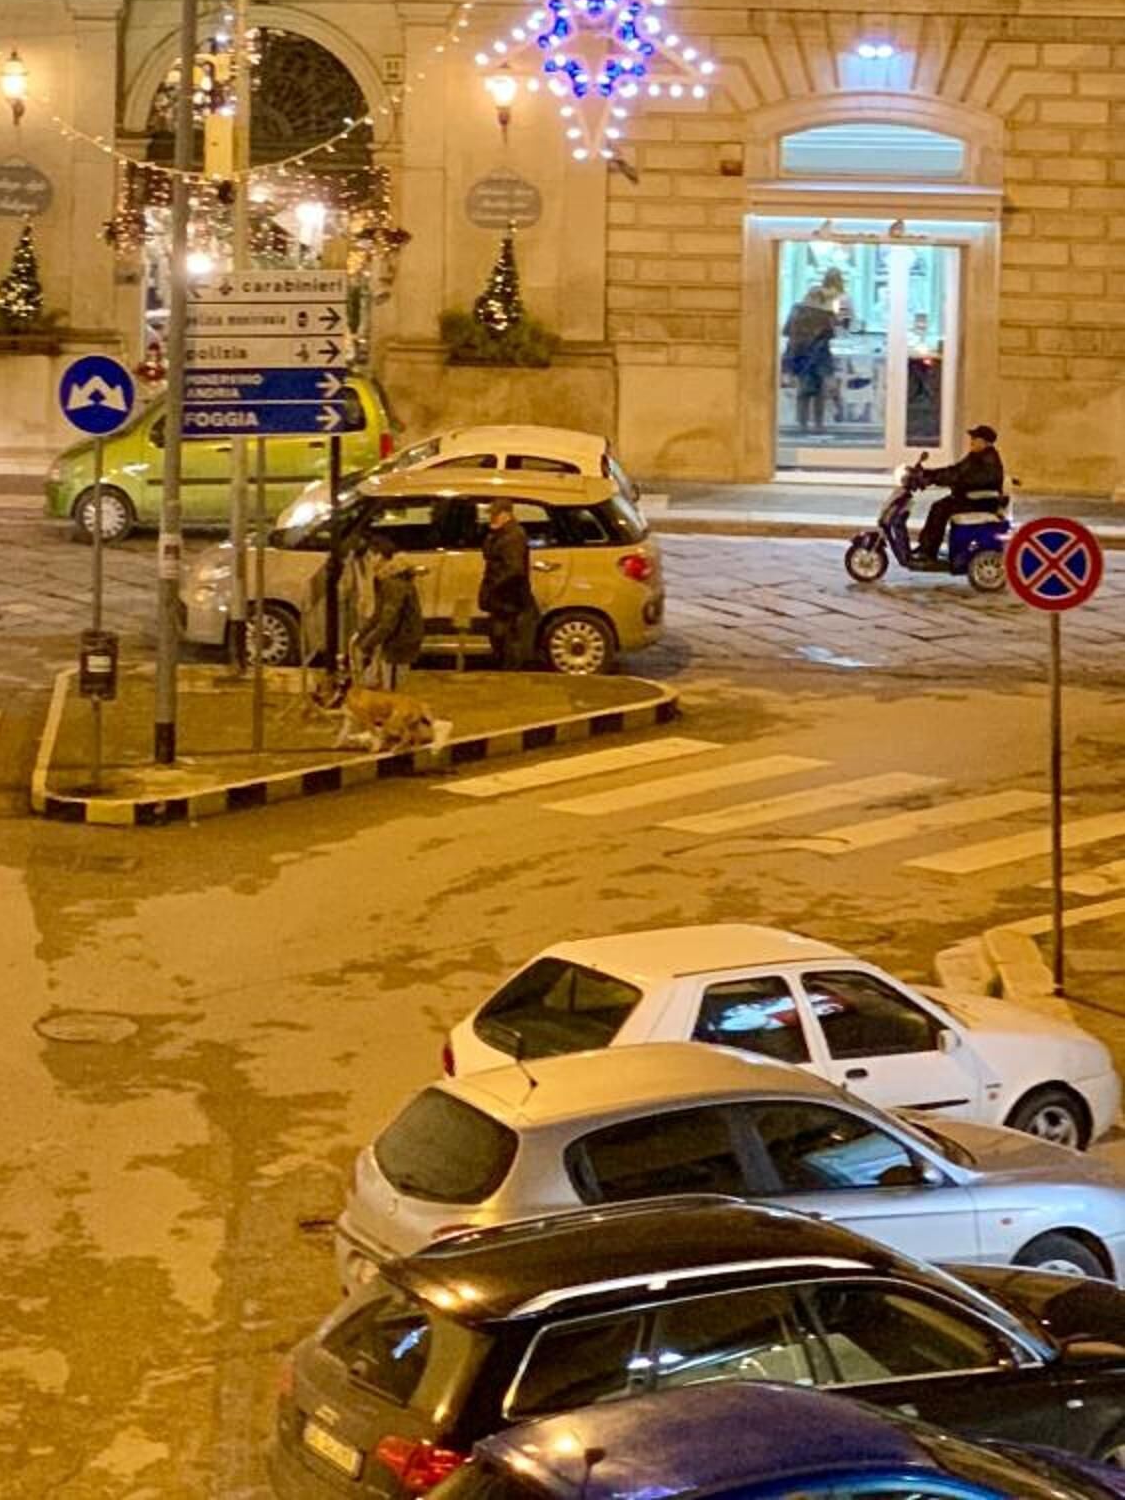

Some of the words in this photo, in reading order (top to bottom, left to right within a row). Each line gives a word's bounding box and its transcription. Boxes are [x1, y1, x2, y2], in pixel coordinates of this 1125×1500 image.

[241, 278, 344, 293] carabinieri
[186, 344, 248, 361] polizia
[184, 410, 260, 428] FOGGIA
